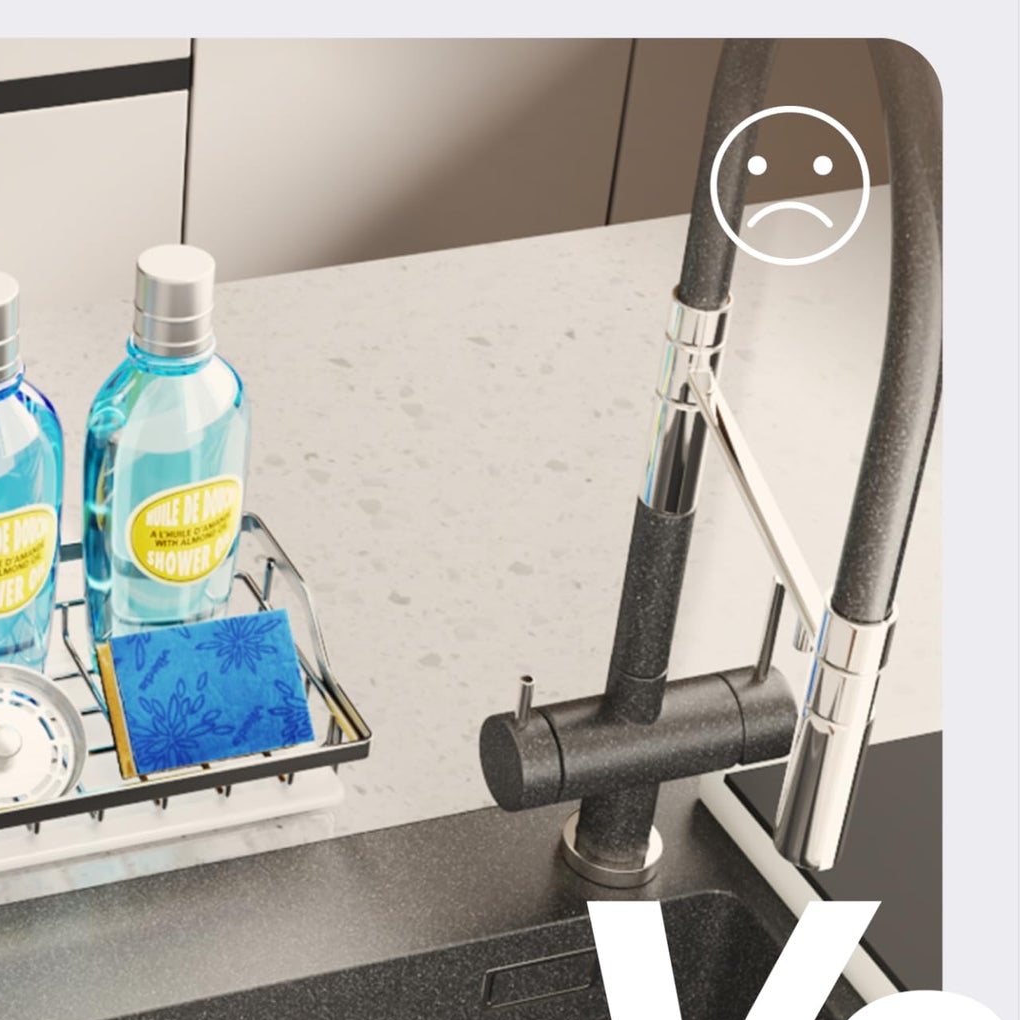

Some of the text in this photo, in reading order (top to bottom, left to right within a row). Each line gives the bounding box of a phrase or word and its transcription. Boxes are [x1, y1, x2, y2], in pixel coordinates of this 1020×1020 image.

[183, 492, 200, 526] DE
[155, 539, 178, 547] WITH
[146, 544, 211, 577] SHOWER
